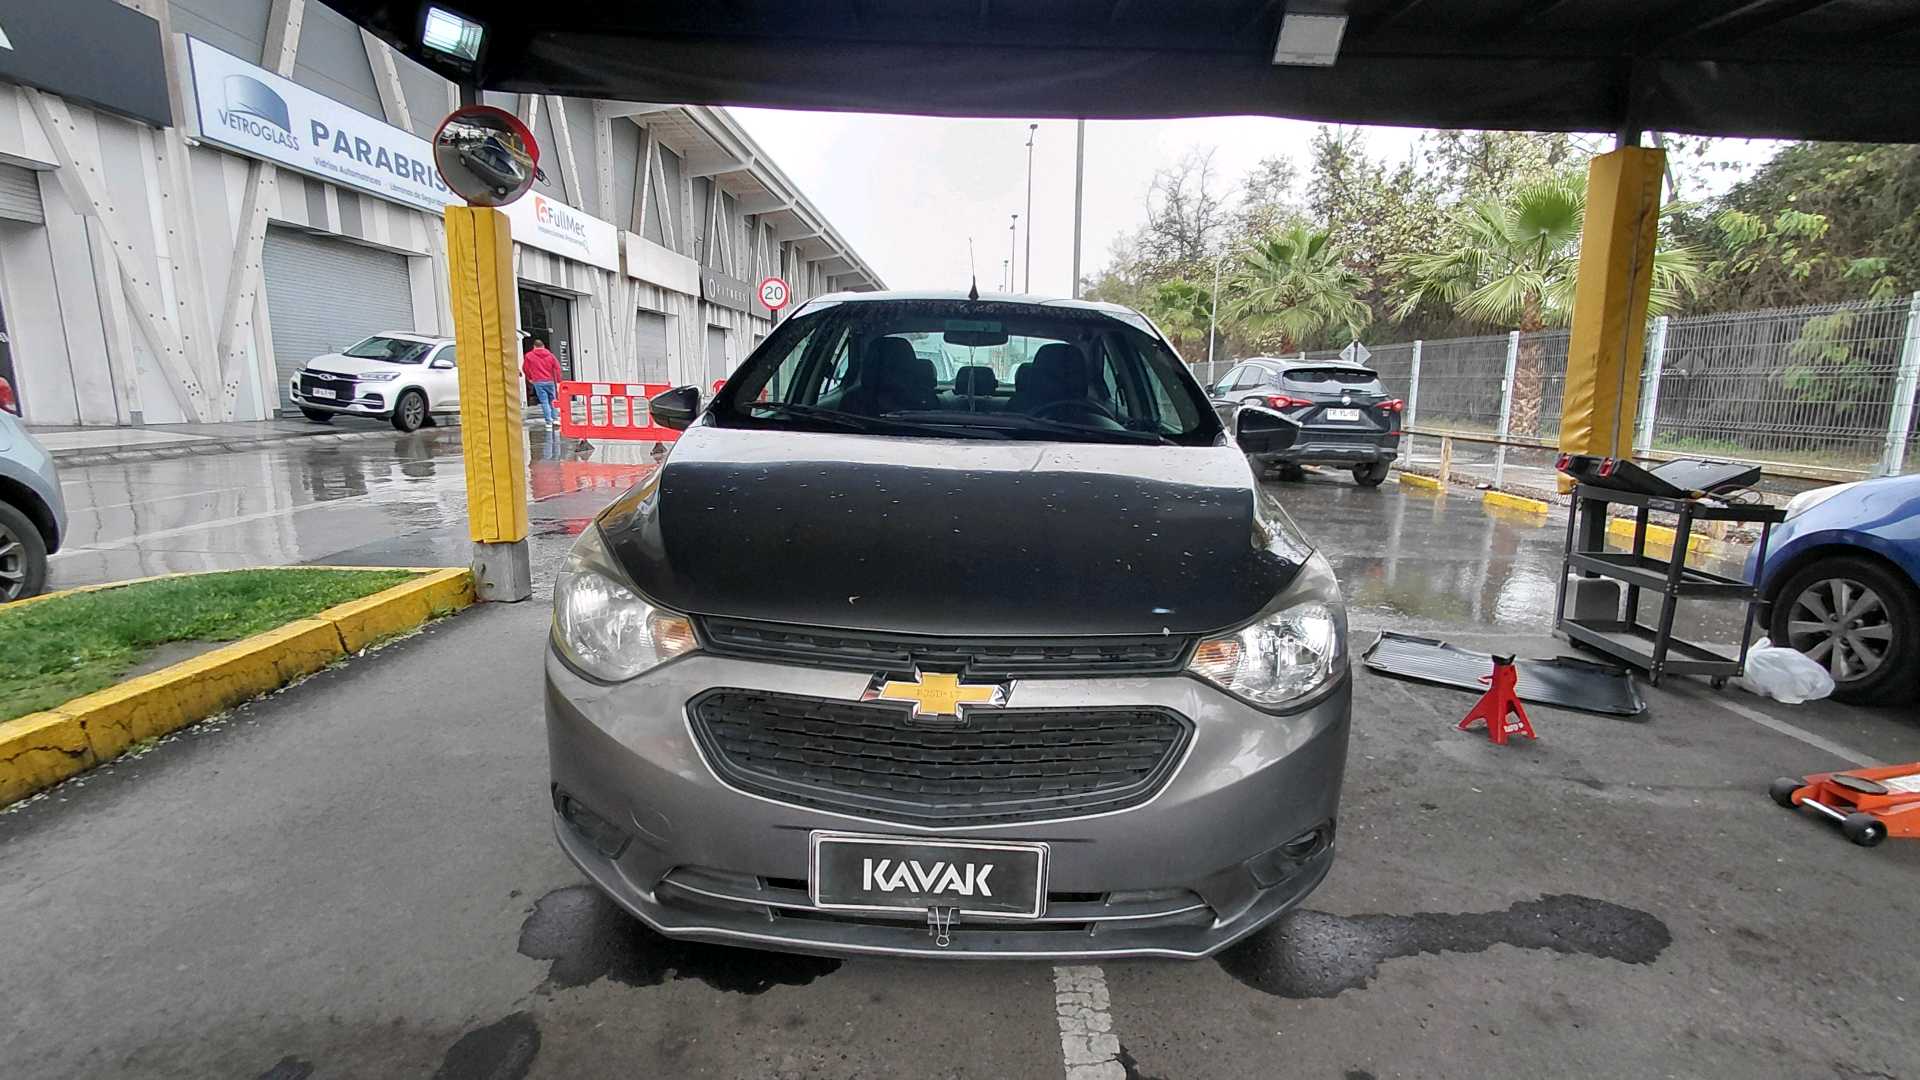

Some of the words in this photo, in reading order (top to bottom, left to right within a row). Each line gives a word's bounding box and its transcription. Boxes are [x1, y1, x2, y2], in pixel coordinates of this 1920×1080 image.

[218, 108, 300, 151] VETROGLASS
[310, 119, 454, 195] PARABRIS
[547, 207, 587, 238] FullMec
[764, 286, 784, 300] 20
[862, 858, 994, 897] KAVAK
